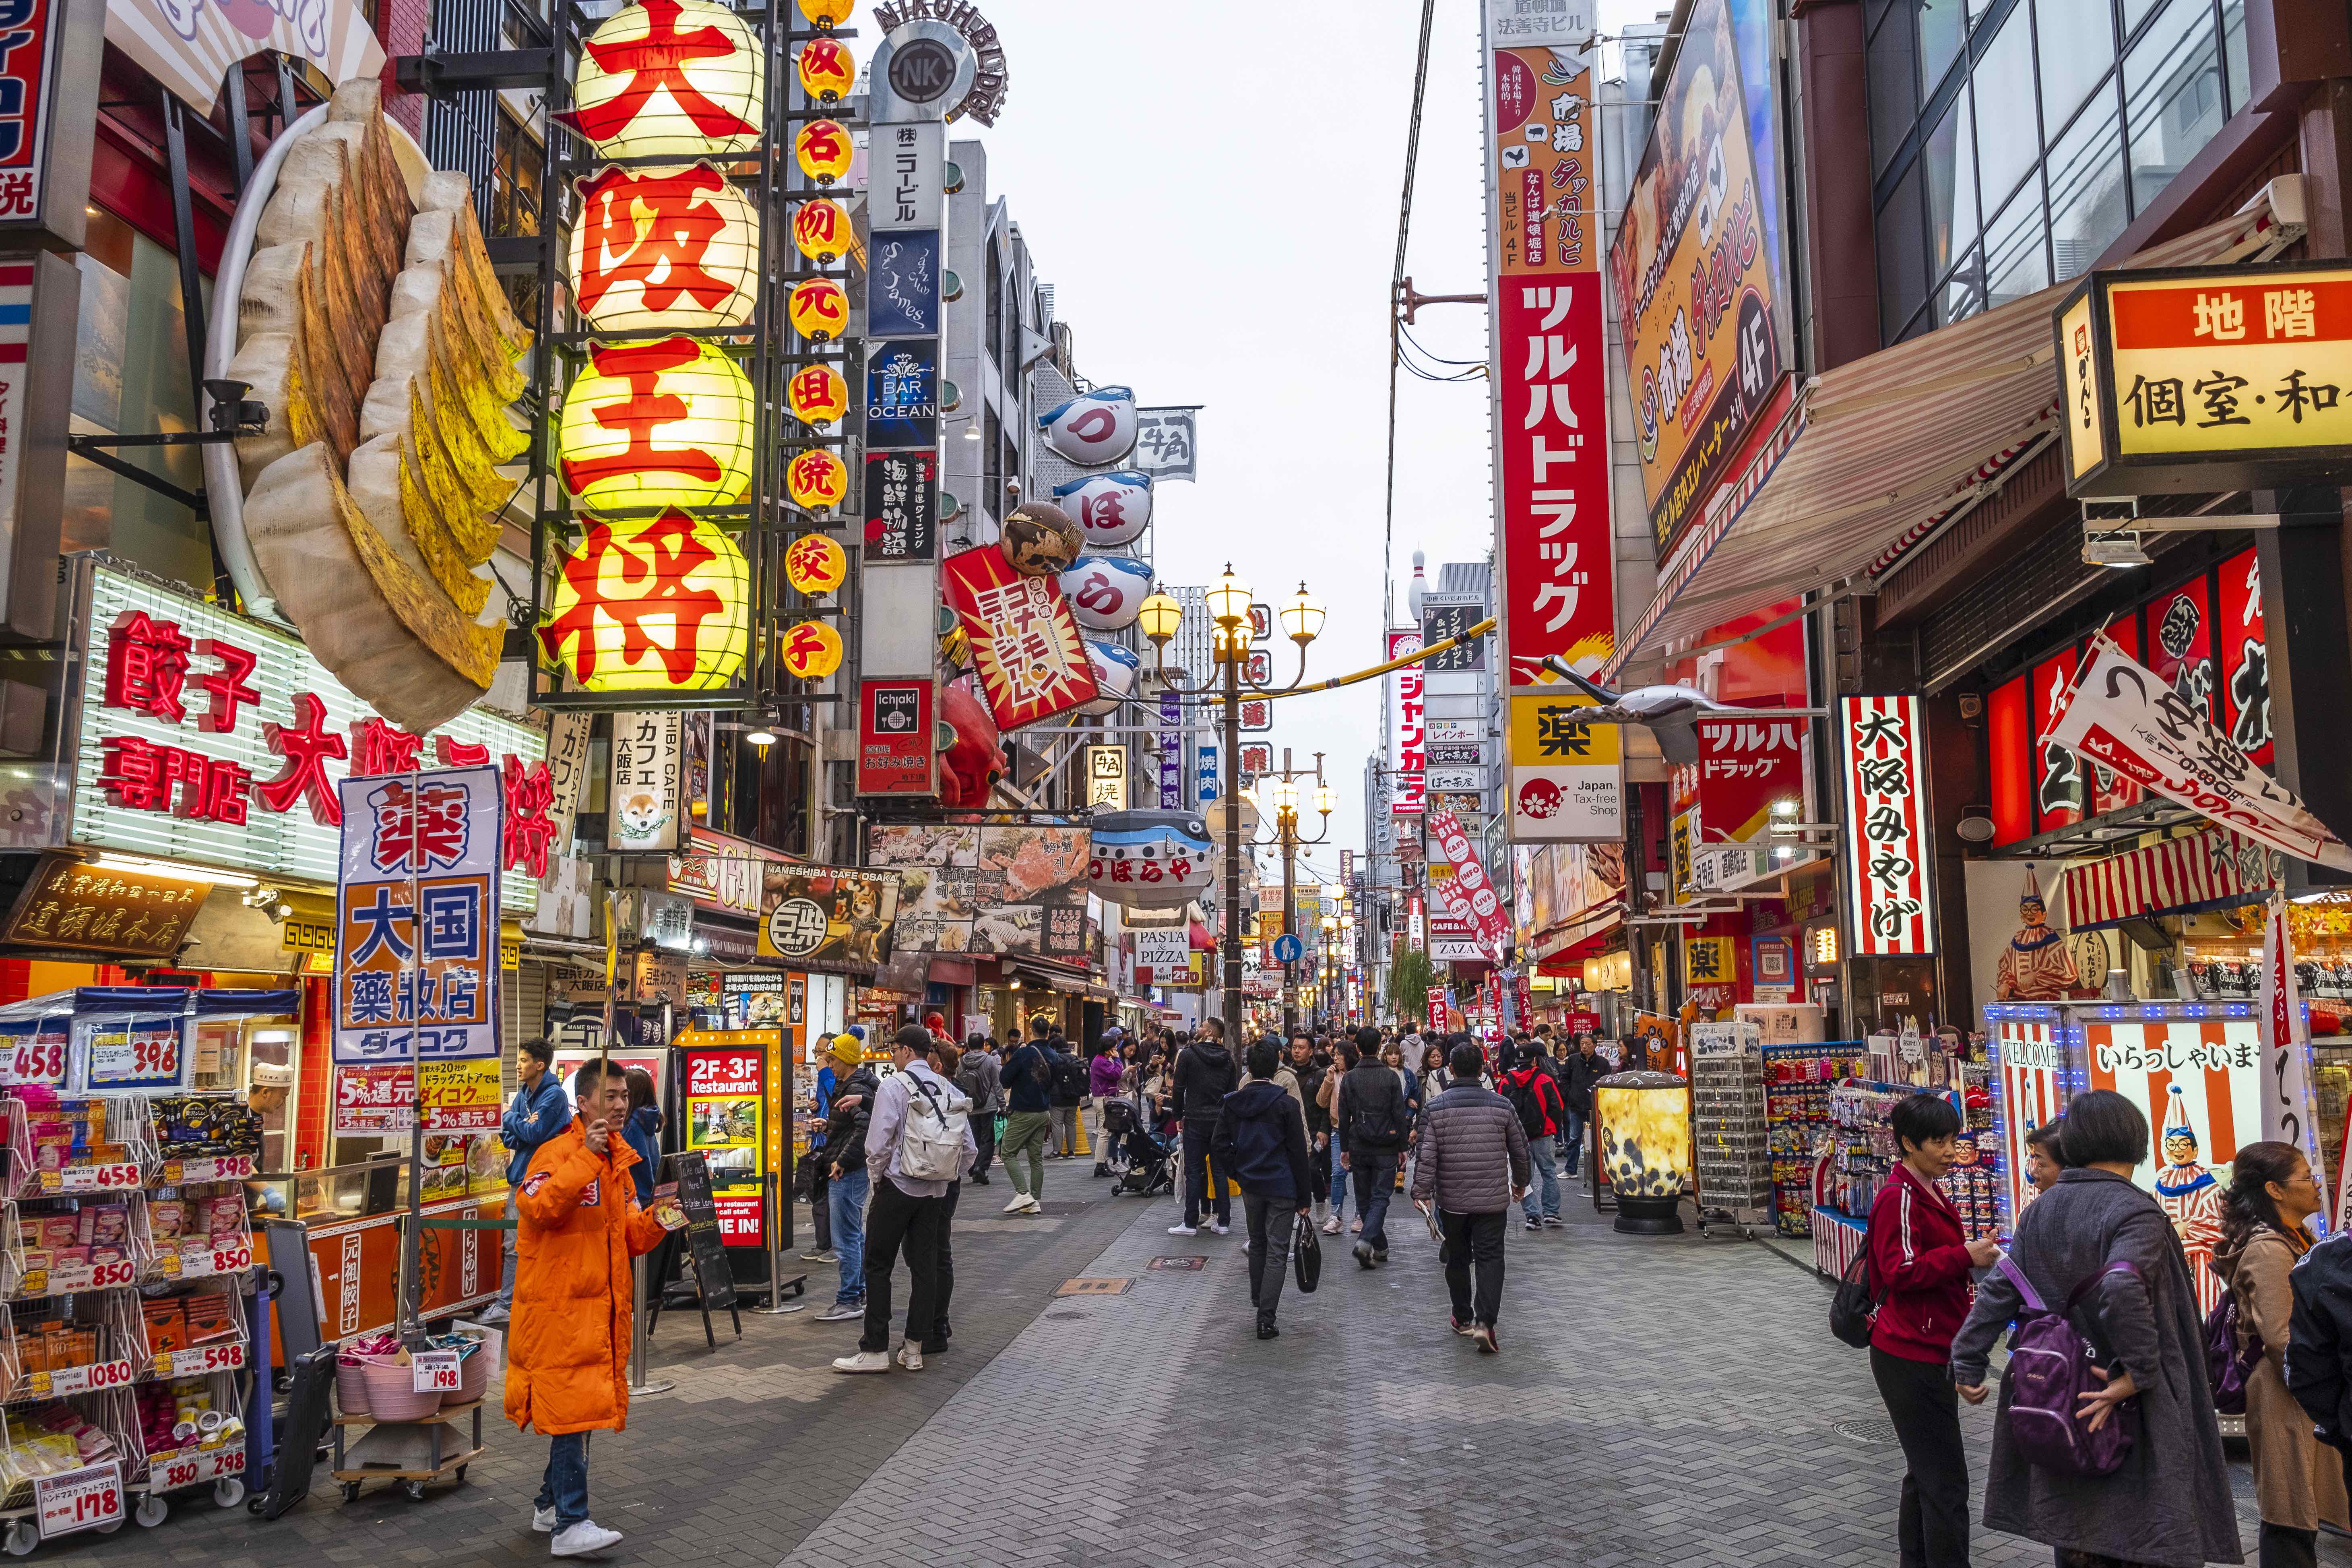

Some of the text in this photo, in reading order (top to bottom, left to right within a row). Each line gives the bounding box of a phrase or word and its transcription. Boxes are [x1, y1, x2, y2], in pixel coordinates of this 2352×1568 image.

[1498, 16, 1585, 35] 法善寺ビル
[1512, 64, 1522, 117] 韓国本場より
[1527, 172, 1542, 263] なんば道頓堀店
[886, 271, 924, 321] James
[2194, 289, 2316, 340] 地階
[538, 0, 760, 684] 大阪王将
[1742, 310, 1766, 397] 4F
[883, 381, 921, 394] BAR
[2124, 369, 2352, 429] 個室・和
[869, 405, 934, 418] OCEAN
[1138, 428, 1188, 462] 牛角
[1522, 286, 1587, 633] ツルハドラッグ
[882, 459, 908, 556] 海鮮物語
[915, 463, 925, 549] 漁港直送ダイニング
[1029, 578, 1052, 619] 道頓堀
[1425, 609, 1435, 619] 2F
[103, 610, 261, 733] 餃子
[1401, 674, 1425, 801] ジャンカラ
[1433, 730, 1474, 740] レインボー
[1538, 705, 1591, 756] 薬
[1702, 723, 1797, 752] ツルハ
[635, 712, 659, 785] カフェ
[865, 745, 890, 754] 道頓堀
[1436, 751, 1470, 760] ぼて茶屋
[616, 738, 633, 785] 大阪店
[864, 756, 926, 769] お好み焼き
[1097, 755, 1119, 773] 牛角
[1705, 758, 1780, 778] ドラッグ
[902, 773, 925, 781] 地下1階
[1200, 755, 1216, 791] 焼肉
[1431, 776, 1474, 788] ぼて茶屋
[567, 767, 580, 817] CAFE
[663, 764, 676, 810] CAFE
[1577, 781, 1616, 791] Japan.
[1573, 794, 1617, 804] Tax-free
[1590, 806, 1617, 818] Shop
[372, 781, 465, 868] 薬
[1856, 712, 1921, 938] 大阪みやげ
[881, 847, 927, 860] 어서오세요
[1448, 839, 1466, 853] CAFE
[1053, 857, 1065, 869] 계
[1460, 866, 1480, 881] INFO
[680, 874, 707, 887] GAME HOUSE
[766, 865, 897, 883] MAMESHIBA CAFE OSAKA
[1451, 903, 1468, 915] CAFE
[1474, 893, 1492, 908] LIVE
[351, 886, 480, 965] 大国
[1140, 932, 1187, 943] PASTA
[1140, 950, 1186, 963] PIZZA
[1439, 944, 1475, 954] ZAZA
[1690, 942, 1720, 978] 薬
[645, 968, 677, 986] 豆柴カフェ
[725, 974, 782, 982] 道頓堀川を眺めながら
[1173, 970, 1188, 980] 2F
[2220, 973, 2244, 983] OSAKA
[361, 1029, 468, 1056] ダイコク
[14, 1045, 62, 1078] 458
[134, 1042, 176, 1073] 398
[2003, 1042, 2058, 1068] WELCOME
[2098, 1043, 2261, 1072] いらっしゃいま
[425, 1074, 500, 1086] ドラッグストアでは
[691, 1079, 758, 1093] Restaurant
[420, 1085, 477, 1106] ダイコク
[429, 1107, 485, 1128] 5%還元
[695, 1102, 708, 1112] 3F
[97, 1165, 139, 1186] 458
[214, 1156, 251, 1178] 398
[688, 1197, 714, 1208] Order Lane
[738, 1219, 759, 1233] IN!
[213, 1249, 250, 1271] 850
[93, 1262, 134, 1287] 850
[342, 1237, 359, 1330] 元祖餃子
[204, 1345, 243, 1369] 598
[87, 1361, 130, 1388] 1080
[433, 1370, 457, 1388] 198
[213, 1452, 245, 1475] 298
[167, 1463, 197, 1486] 380
[44, 1507, 72, 1519] 各種
[75, 1489, 119, 1522] 178
